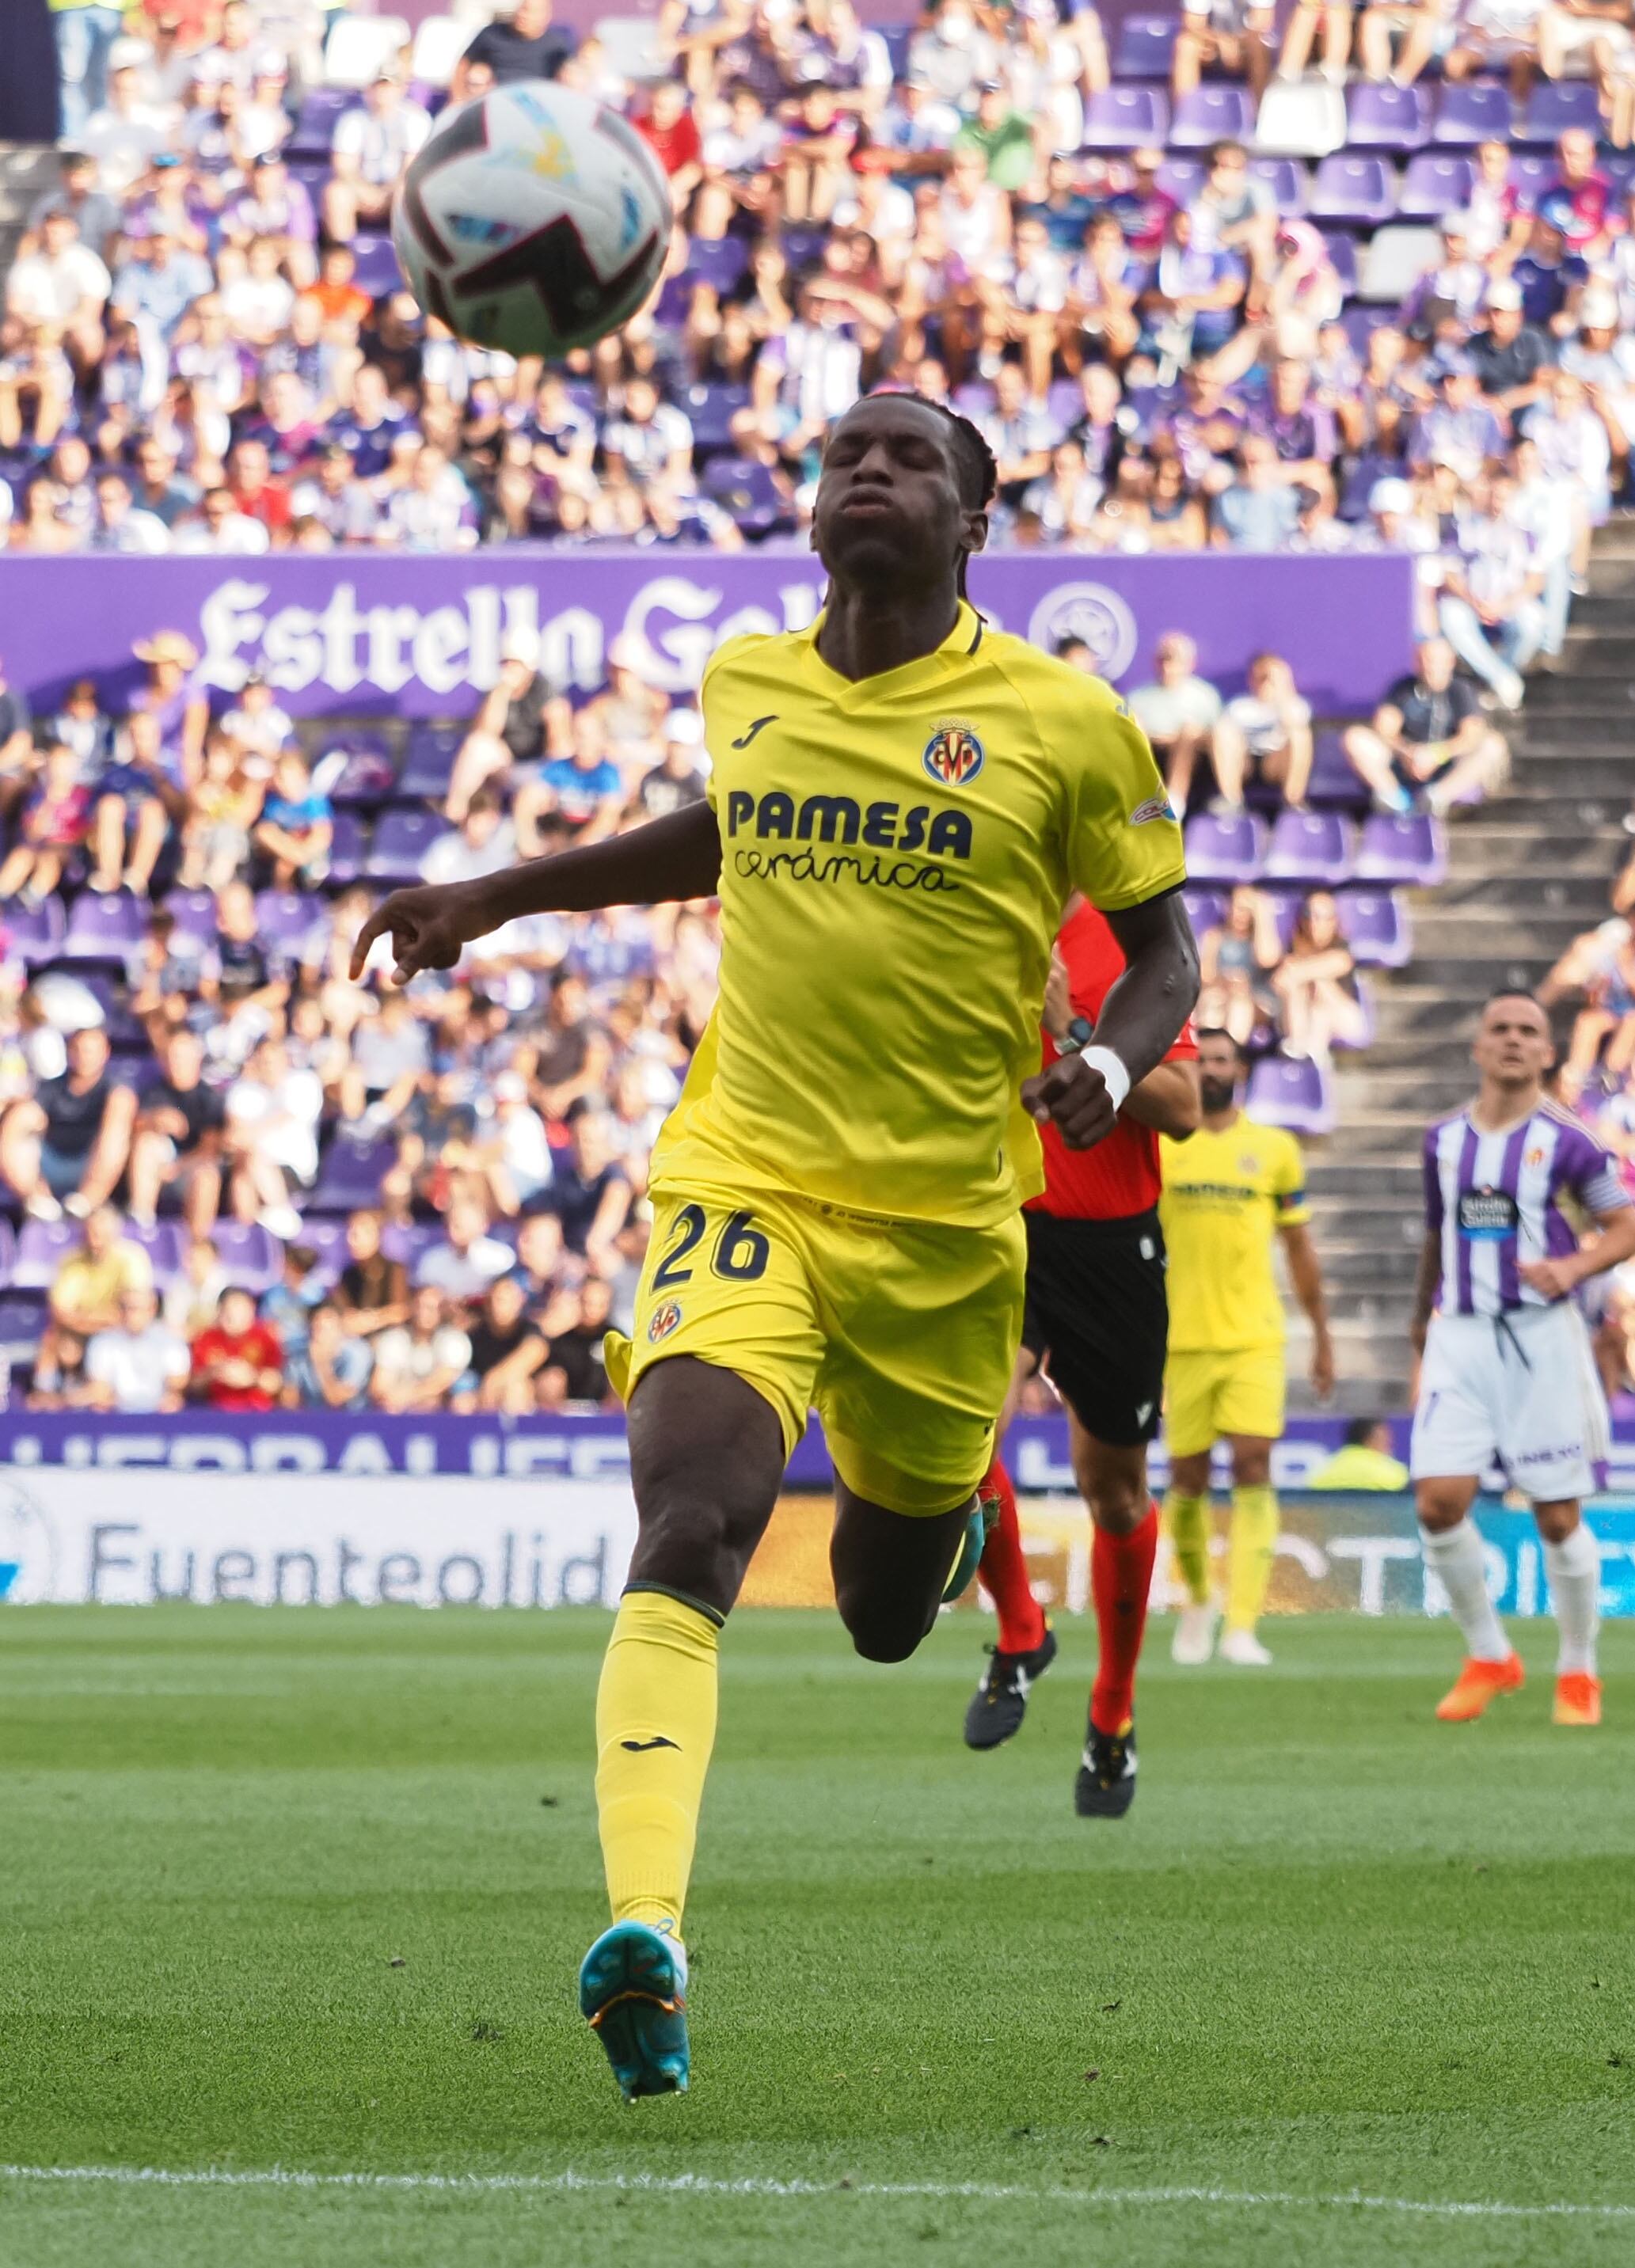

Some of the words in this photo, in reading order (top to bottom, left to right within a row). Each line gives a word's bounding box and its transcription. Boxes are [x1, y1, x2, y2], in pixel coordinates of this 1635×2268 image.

[198, 578, 606, 694] Estrella
[728, 791, 972, 860] PAMESA
[735, 847, 960, 891] cerámica
[649, 1203, 770, 1296] 26
[90, 1522, 608, 1607] Fuenteolid
